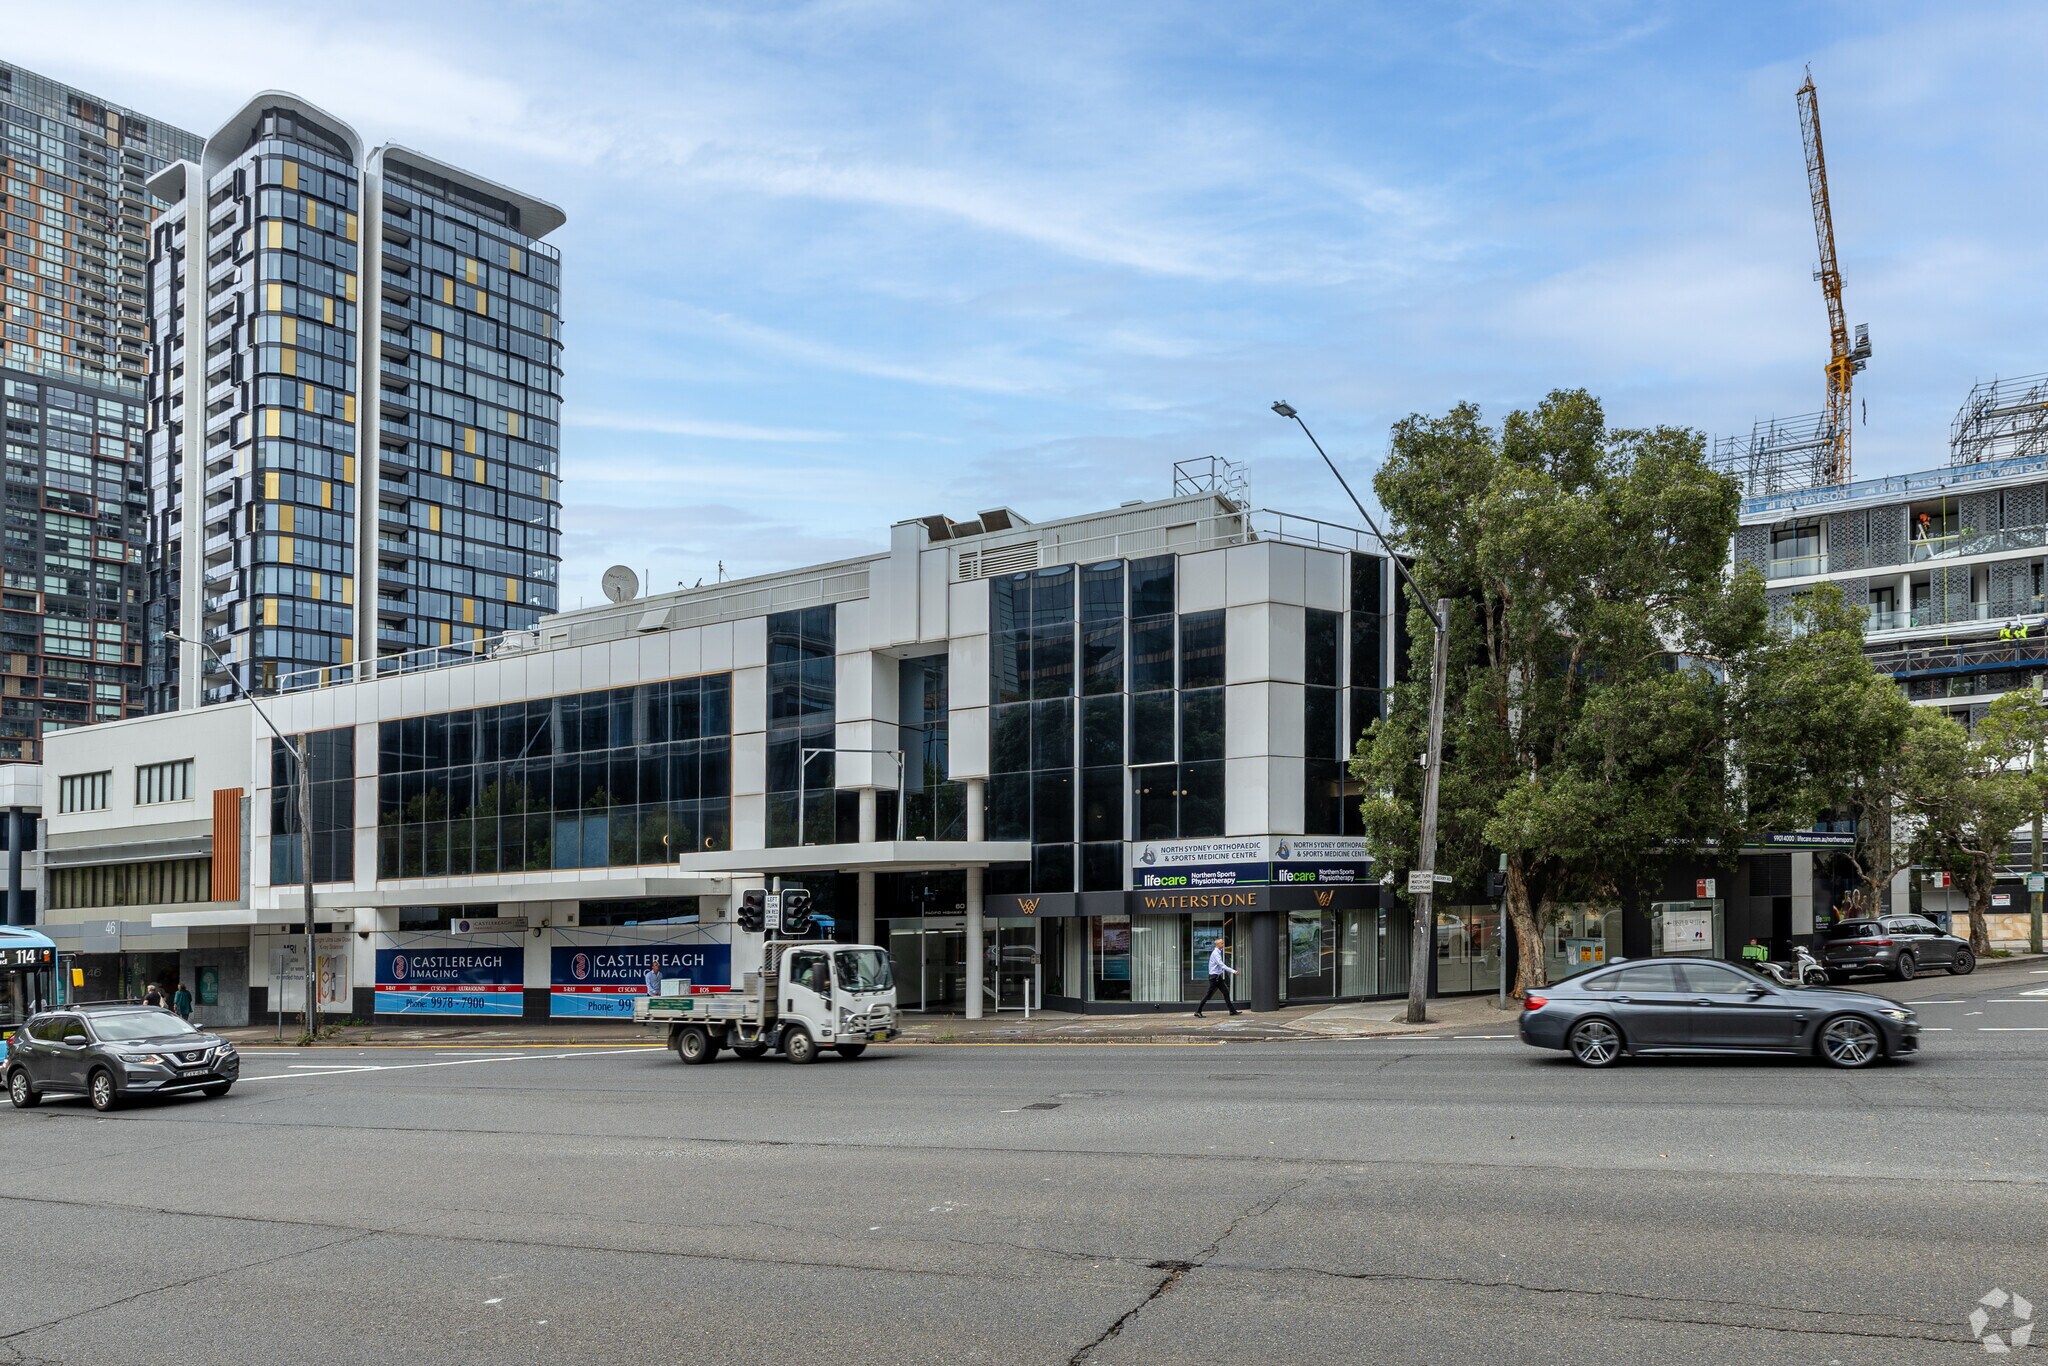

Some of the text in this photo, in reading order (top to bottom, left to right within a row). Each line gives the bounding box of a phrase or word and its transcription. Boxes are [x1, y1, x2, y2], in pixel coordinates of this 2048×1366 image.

[1880, 476, 1953, 493] RM WATSON
[1780, 490, 1849, 508] RM WATSON
[1185, 844, 1212, 852] SYDNEY
[1213, 841, 1261, 851] ORTHOPAEDIC
[1172, 854, 1196, 862] SPORTS
[1197, 852, 1230, 860] MEDICINE
[1232, 851, 1257, 859] CENTRE
[1144, 874, 1187, 887] lifecare
[1278, 869, 1316, 882] lifecare
[1319, 874, 1355, 882] Physiotherapy
[1191, 878, 1236, 886] Physiotherapy
[1145, 892, 1257, 909] WATERSTONE
[105, 921, 116, 935] 46
[16, 949, 36, 964] 114
[412, 956, 502, 968] CASTLEREAGH
[596, 954, 704, 966] CASTLEREAGH
[86, 968, 102, 978] 46
[412, 969, 459, 978] IMAGING
[406, 998, 428, 1008] Phone:
[431, 997, 453, 1008] 9978
[462, 997, 485, 1008] 7900
[588, 1001, 614, 1012] Phone:
